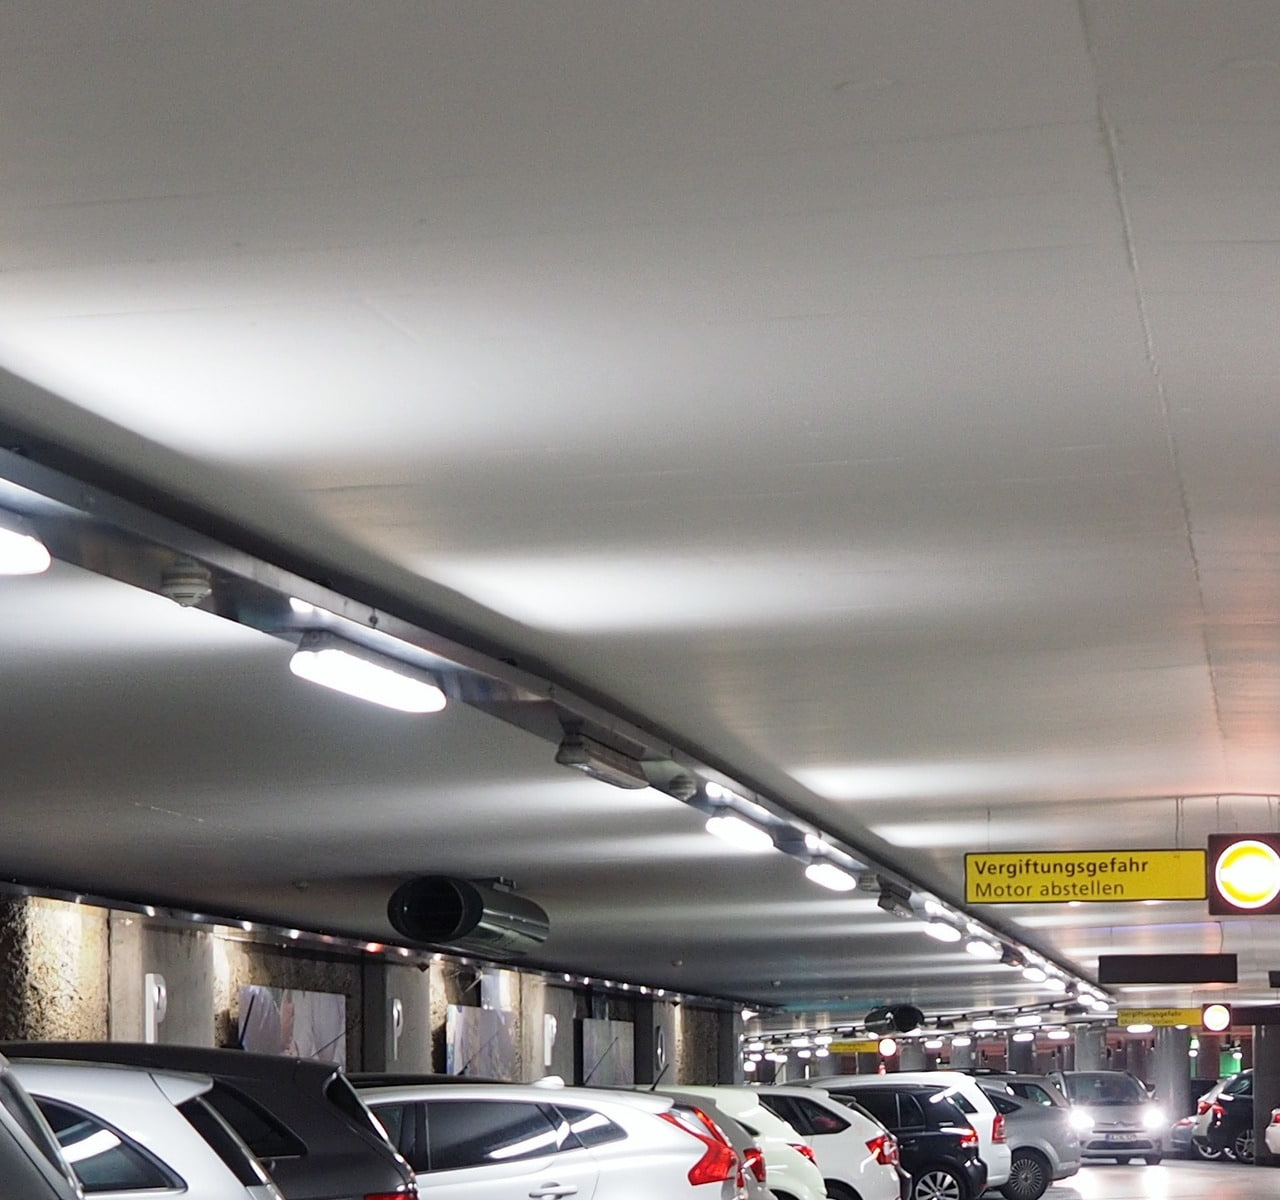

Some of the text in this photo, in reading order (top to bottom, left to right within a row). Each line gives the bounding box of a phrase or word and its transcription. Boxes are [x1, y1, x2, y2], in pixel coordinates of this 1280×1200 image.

[974, 857, 1149, 879] Vergiftungsgefahr
[975, 880, 1125, 898] Motor abstellen
[145, 973, 167, 1044] P
